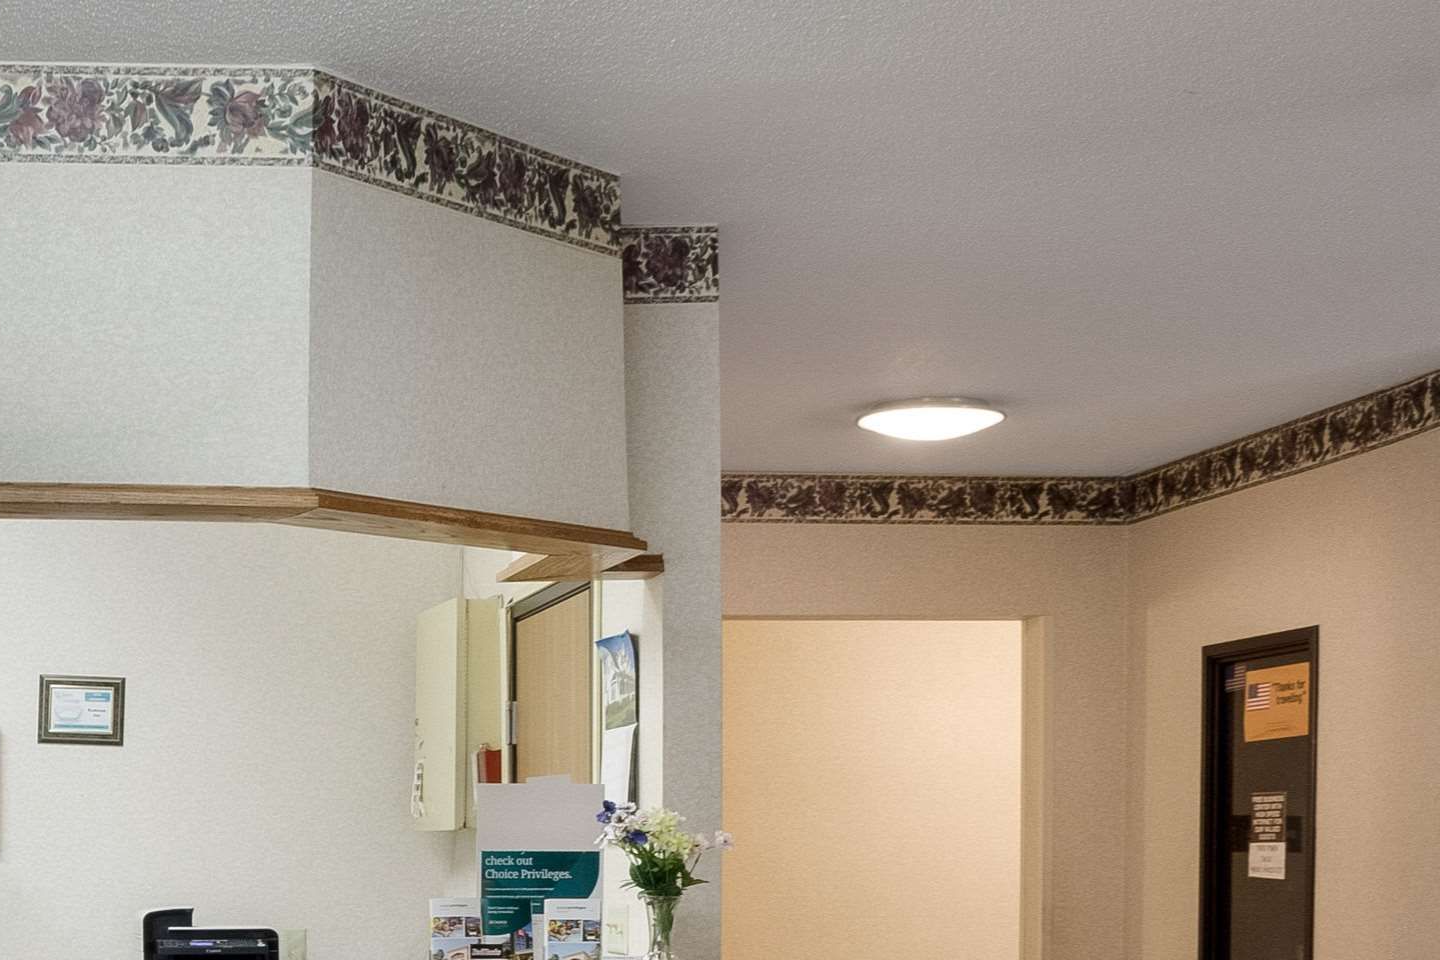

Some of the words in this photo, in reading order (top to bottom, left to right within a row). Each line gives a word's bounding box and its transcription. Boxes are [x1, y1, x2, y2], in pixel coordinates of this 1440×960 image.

[485, 856, 514, 866] check
[516, 857, 533, 866] out
[485, 869, 519, 879] Choice
[521, 869, 573, 881] Privileges.
